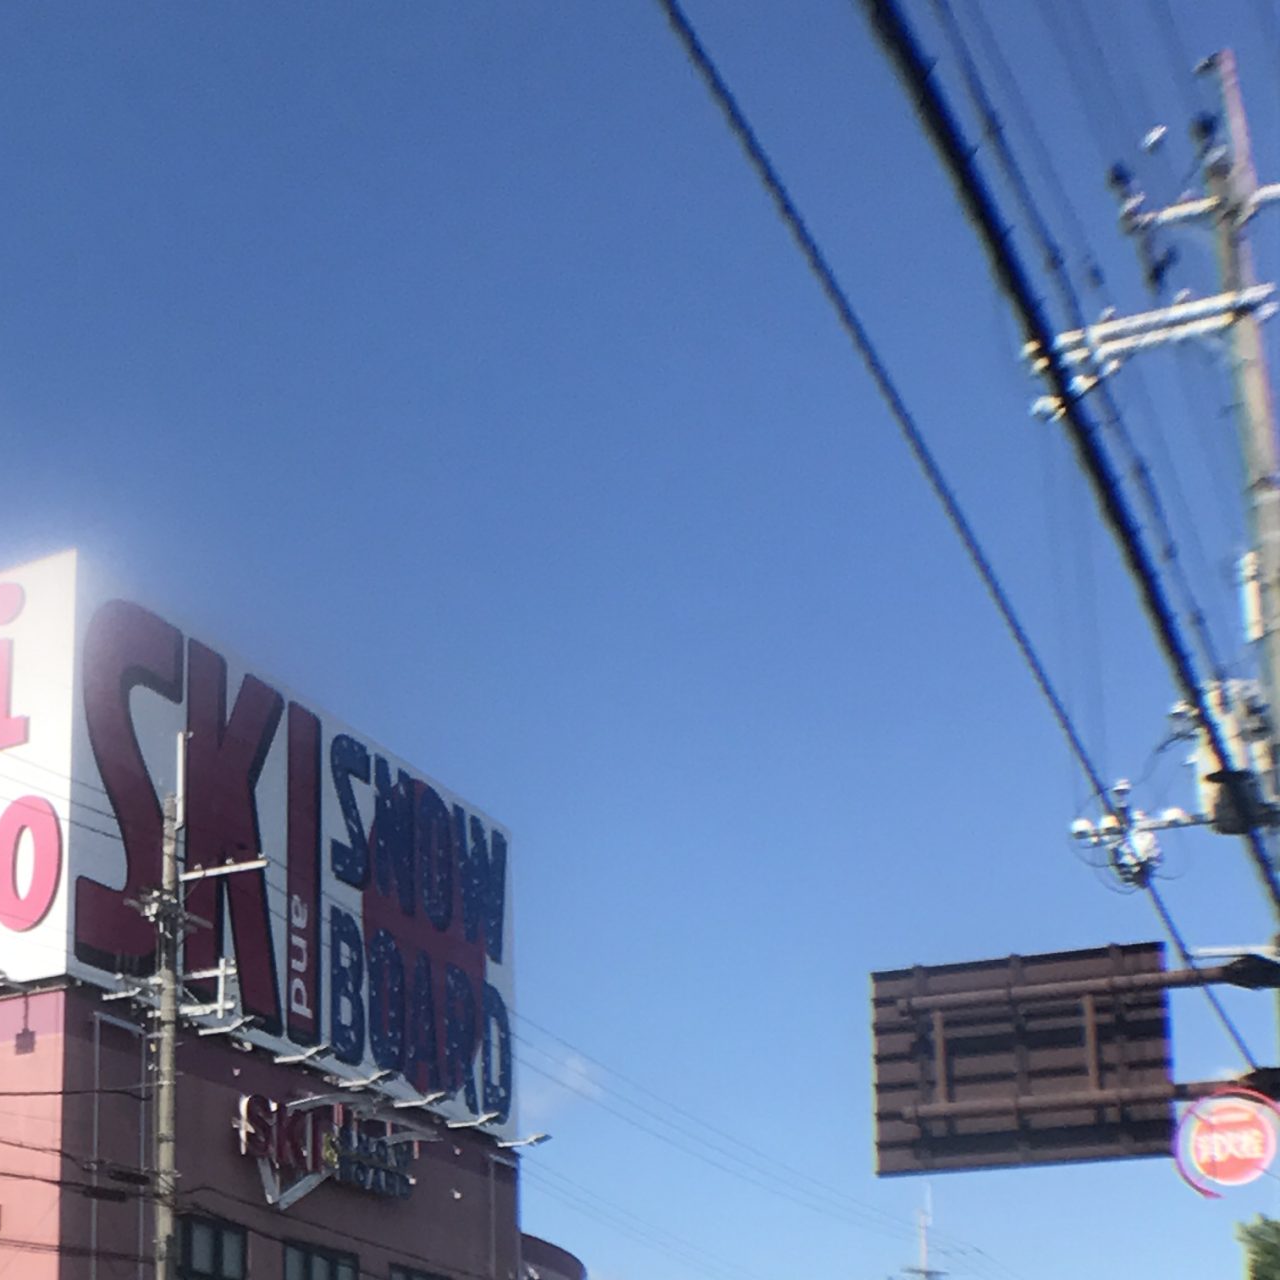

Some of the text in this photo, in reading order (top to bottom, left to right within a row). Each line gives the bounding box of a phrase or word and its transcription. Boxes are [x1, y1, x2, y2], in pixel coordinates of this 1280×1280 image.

[74, 598, 322, 1046] SKI
[330, 734, 508, 966] SNOW
[290, 893, 313, 1019] and
[330, 904, 513, 1126] BOARD
